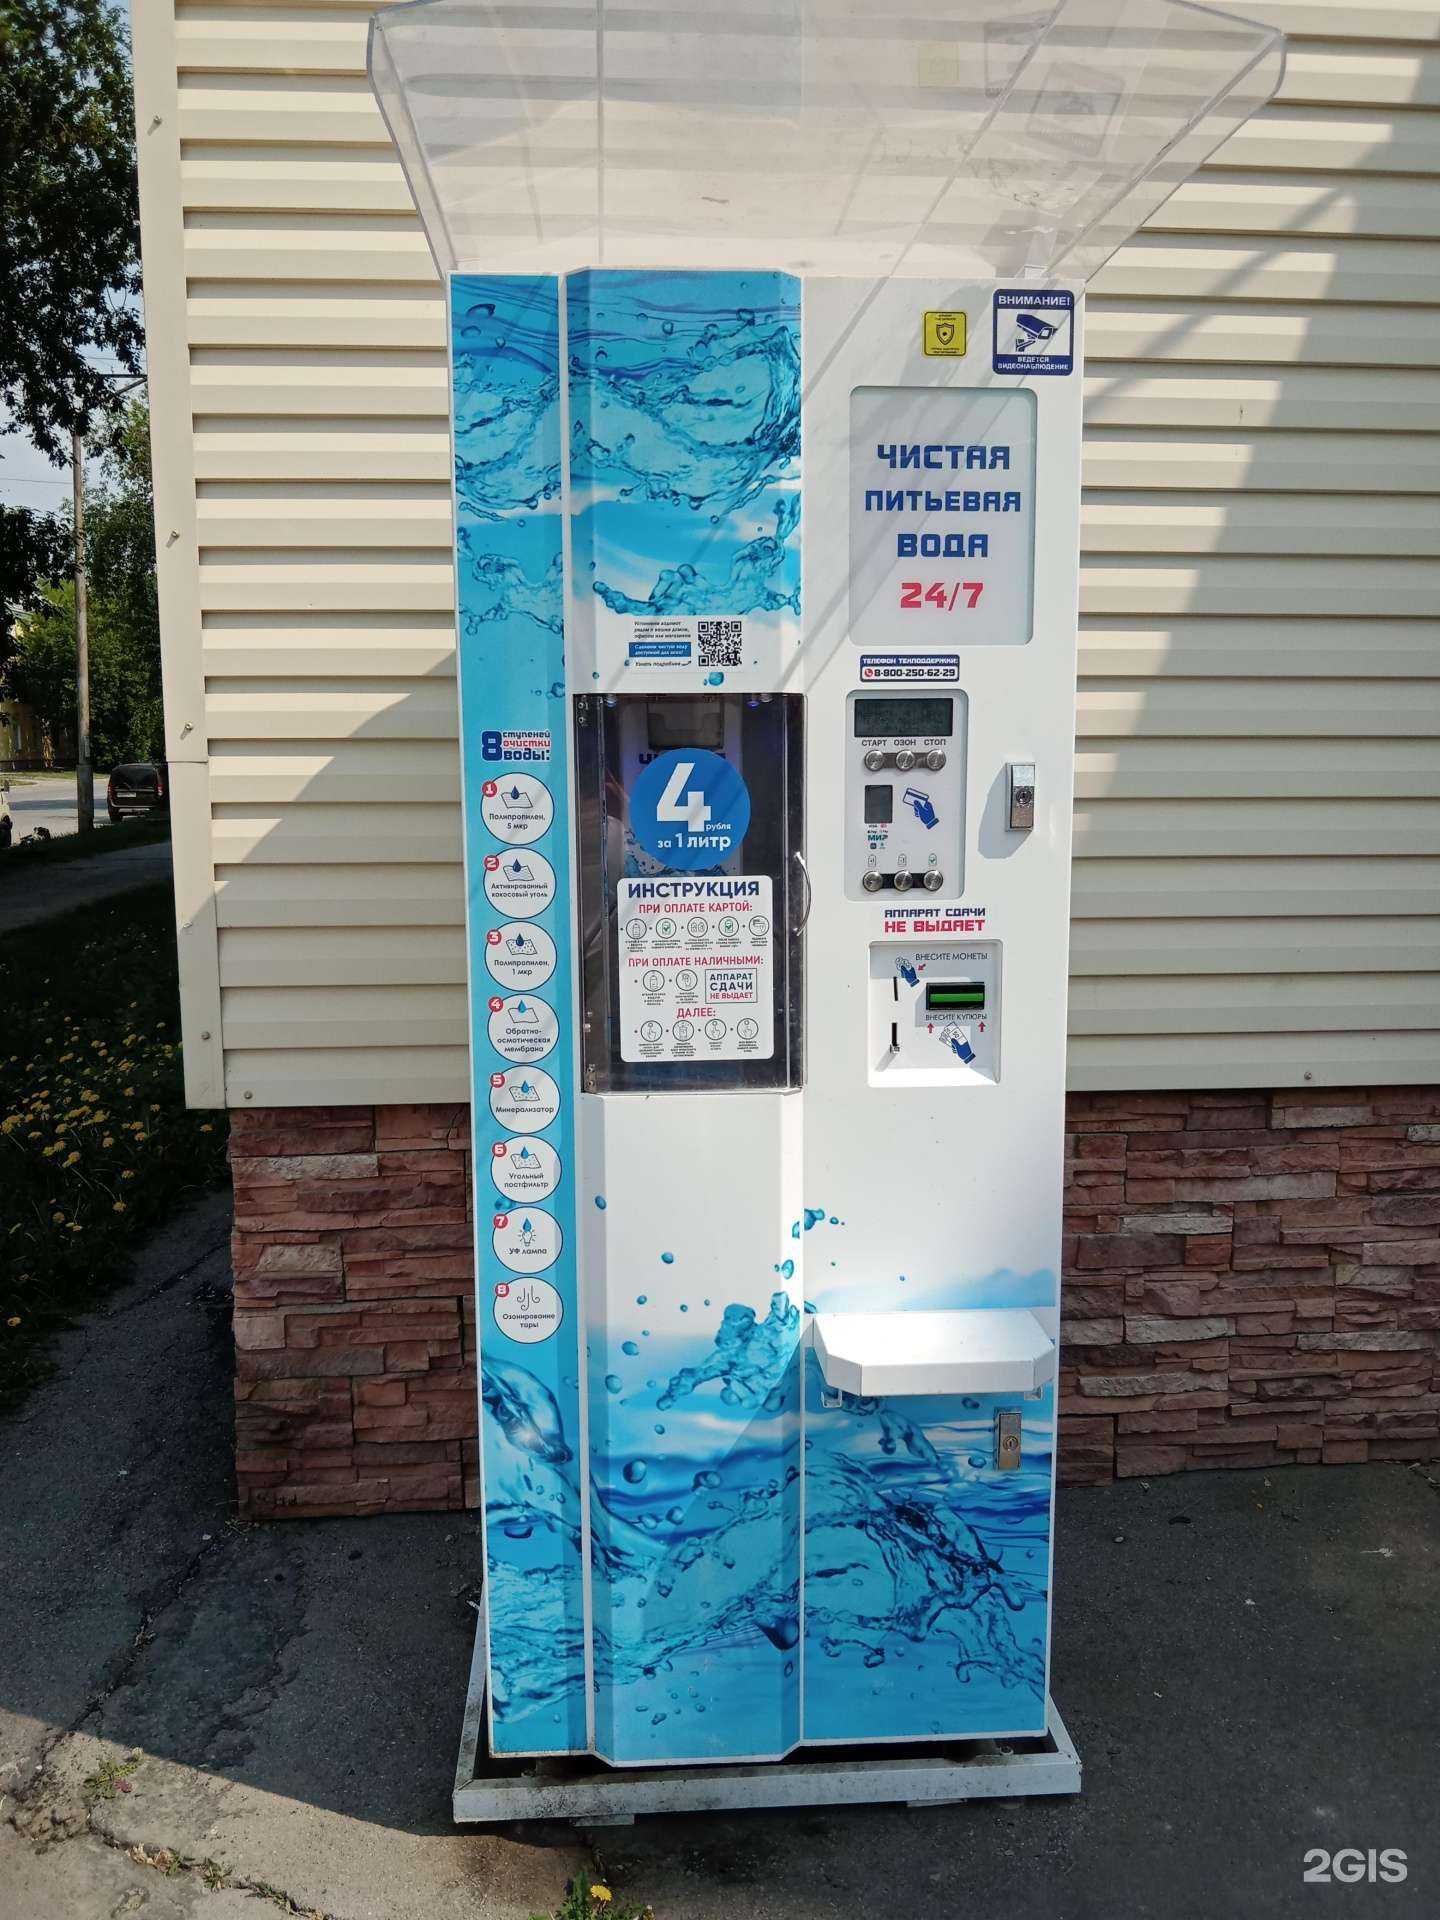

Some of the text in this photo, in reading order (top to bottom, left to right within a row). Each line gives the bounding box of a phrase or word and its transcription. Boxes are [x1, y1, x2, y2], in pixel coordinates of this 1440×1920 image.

[998, 295, 1070, 306] ВНИМАНИЕ!
[997, 362, 1069, 370] ВИДЕОНАБЛЮДЕНИЕ
[877, 444, 1010, 470] ЧИСТАЯ
[865, 490, 1021, 512] ПИТЬЕВАЯ
[897, 533, 989, 558] ВОДА
[900, 582, 984, 611] 24/7
[874, 668, 956, 677] 8-800-250-62-29
[482, 731, 550, 761] 8 ступеней
[503, 738, 550, 747] очистки
[862, 739, 887, 747] СТАРТ
[924, 738, 946, 746] СТОП
[503, 748, 550, 761] воды:
[485, 784, 494, 795] 1
[656, 762, 712, 833] 4
[489, 813, 546, 821] Полипропилен,
[513, 823, 529, 831] мкр
[706, 822, 732, 831] рубля
[657, 833, 732, 851] за 1 литр
[487, 858, 496, 868] 2
[491, 882, 548, 890] Активированный
[628, 881, 760, 899] ИНСТРУКЦИЯ
[491, 890, 548, 899] кокосовый уголь
[639, 900, 753, 914] ПРИ ОПЛАТЕ КАРТОЙ:
[884, 908, 986, 918] АППАРАТ СДАЧИ
[884, 919, 985, 933] НЕ ВЫДАЕТ
[489, 932, 499, 942] 3
[628, 955, 764, 967] ПРИ ОПЛАТЕ НАЛИЧНЫМИ:
[915, 953, 951, 961] ВНЕСИТЕ
[494, 959, 550, 967] Полипропилен,
[518, 968, 533, 976] мкр
[710, 973, 753, 981] АППАРАТ
[710, 982, 753, 992] СДАЧИ
[721, 992, 753, 1000] ВЫДАЕТ
[490, 999, 500, 1009] 4
[676, 1007, 716, 1019] ДАЛЕЕ:
[505, 1028, 542, 1036] Обратно-
[504, 1045, 544, 1053] мембрана
[492, 1075, 502, 1085] 5
[495, 1105, 554, 1114] Минерализатор
[508, 1172, 544, 1180] Угольный
[504, 1180, 549, 1189] постфильтр
[496, 1216, 505, 1226] 7
[508, 1247, 547, 1255] УФ лампа
[497, 1285, 507, 1295] 8
[502, 1312, 555, 1320] Озонирование
[519, 1321, 539, 1329] тары
